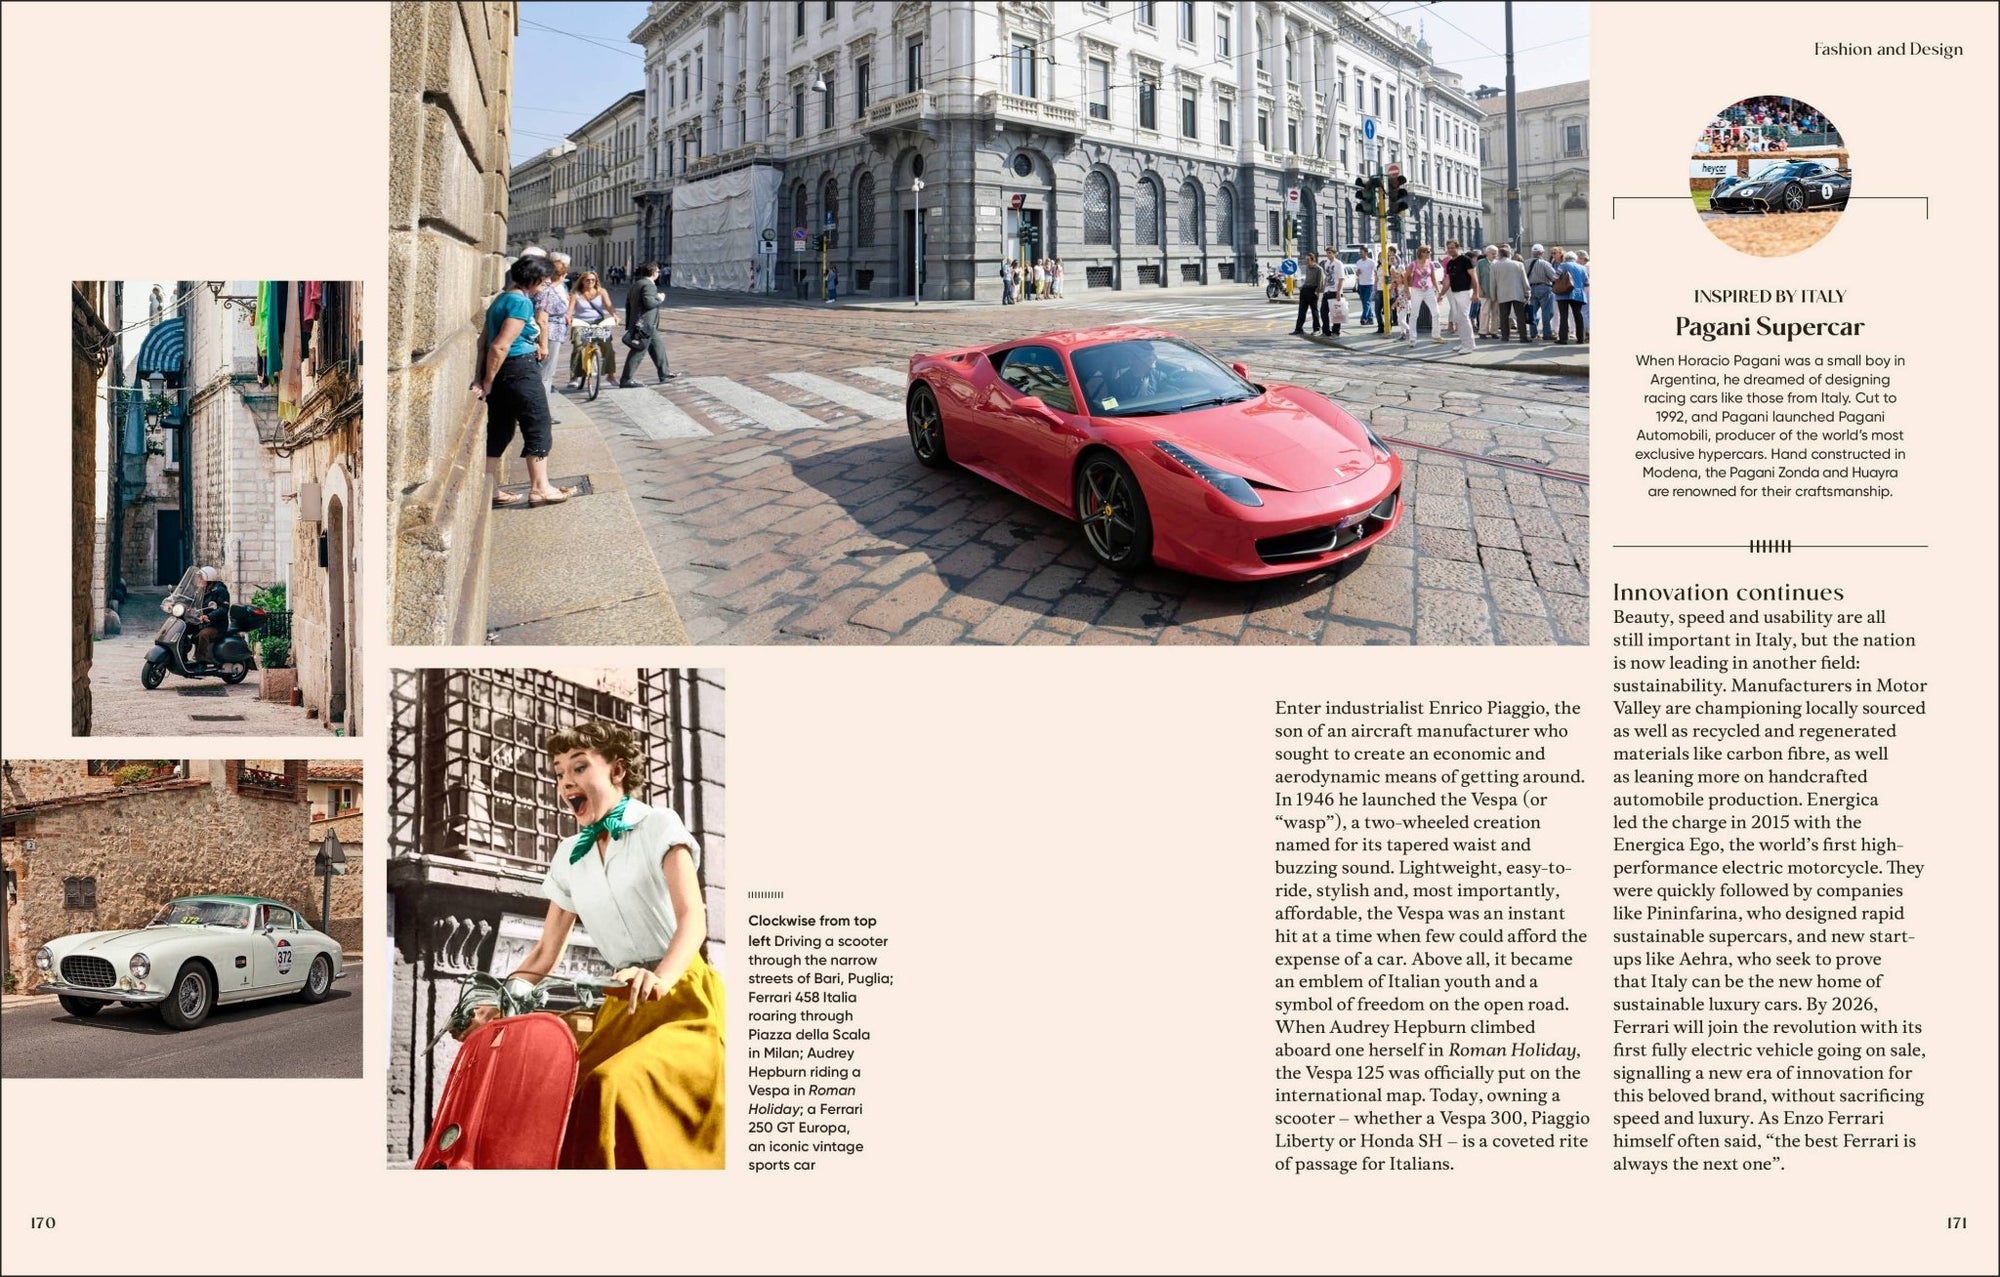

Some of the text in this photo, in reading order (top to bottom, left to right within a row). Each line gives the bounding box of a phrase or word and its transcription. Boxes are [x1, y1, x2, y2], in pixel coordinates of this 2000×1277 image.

[1814, 41, 1964, 60] Fashion and Design
[1702, 162, 1727, 175] heycar
[1694, 289, 1847, 304] INSPIRED BY ITALY
[1676, 315, 1866, 343] Pagani Supercar
[1635, 353, 1906, 370] When Horacio Pagani was a small boy in
[1650, 373, 1891, 389] Argentina, he dreamed of designing
[1643, 391, 1898, 407] racing cars like those from Italy. Cut to
[1655, 410, 1885, 426] 1992, and Pagani launched Pagani
[1636, 428, 1905, 444] Automobili, producer of the world’s most
[1634, 447, 1906, 463] exclusive hypercars. Hand constructed in
[1642, 465, 1899, 482] Modena, the Pagani Zonda and Huayra
[1647, 484, 1894, 500] are renowned for their craftsmanship.
[1613, 582, 1845, 602] Innovation continues
[1613, 609, 1887, 629] Beauty, speed and usability are all
[1275, 700, 1581, 720] Enter industrialist Enrico Piaggio, the
[1613, 722, 1897, 742] as well as recycled and regenerated
[1275, 789, 1548, 811] In 1946 he launched the Vespa (or
[1613, 836, 1904, 856] Energica Ego, the world’s first high-
[1274, 859, 1573, 879] buzzing sound. Lightweight, easy-to-
[748, 914, 878, 930] Clockwise from top
[748, 934, 889, 950] left Driving a scooter
[278, 951, 292, 963] 372
[747, 953, 878, 969] through the narrow
[748, 971, 894, 988] streets of Bari, Puglia;
[748, 990, 857, 1004] Ferrari 458 Italia
[748, 1009, 854, 1025] roaring through
[748, 1027, 871, 1041] Piazza della Scala
[748, 1046, 855, 1062] in Milan; Audrey
[748, 1065, 861, 1081] Hepburn riding a
[1274, 1064, 1581, 1084] the Vespa 125 was officially put on the
[747, 1083, 856, 1099] Vespa in Roman
[747, 1102, 863, 1118] Holiday; a Ferrari
[748, 1121, 851, 1137] 250 GT Europa,
[748, 1140, 865, 1156] an iconic vintage
[748, 1159, 817, 1174] sports car
[1613, 1156, 1785, 1175] always the next one”.
[31, 1216, 56, 1230] 170
[1947, 1216, 1967, 1230] 171
